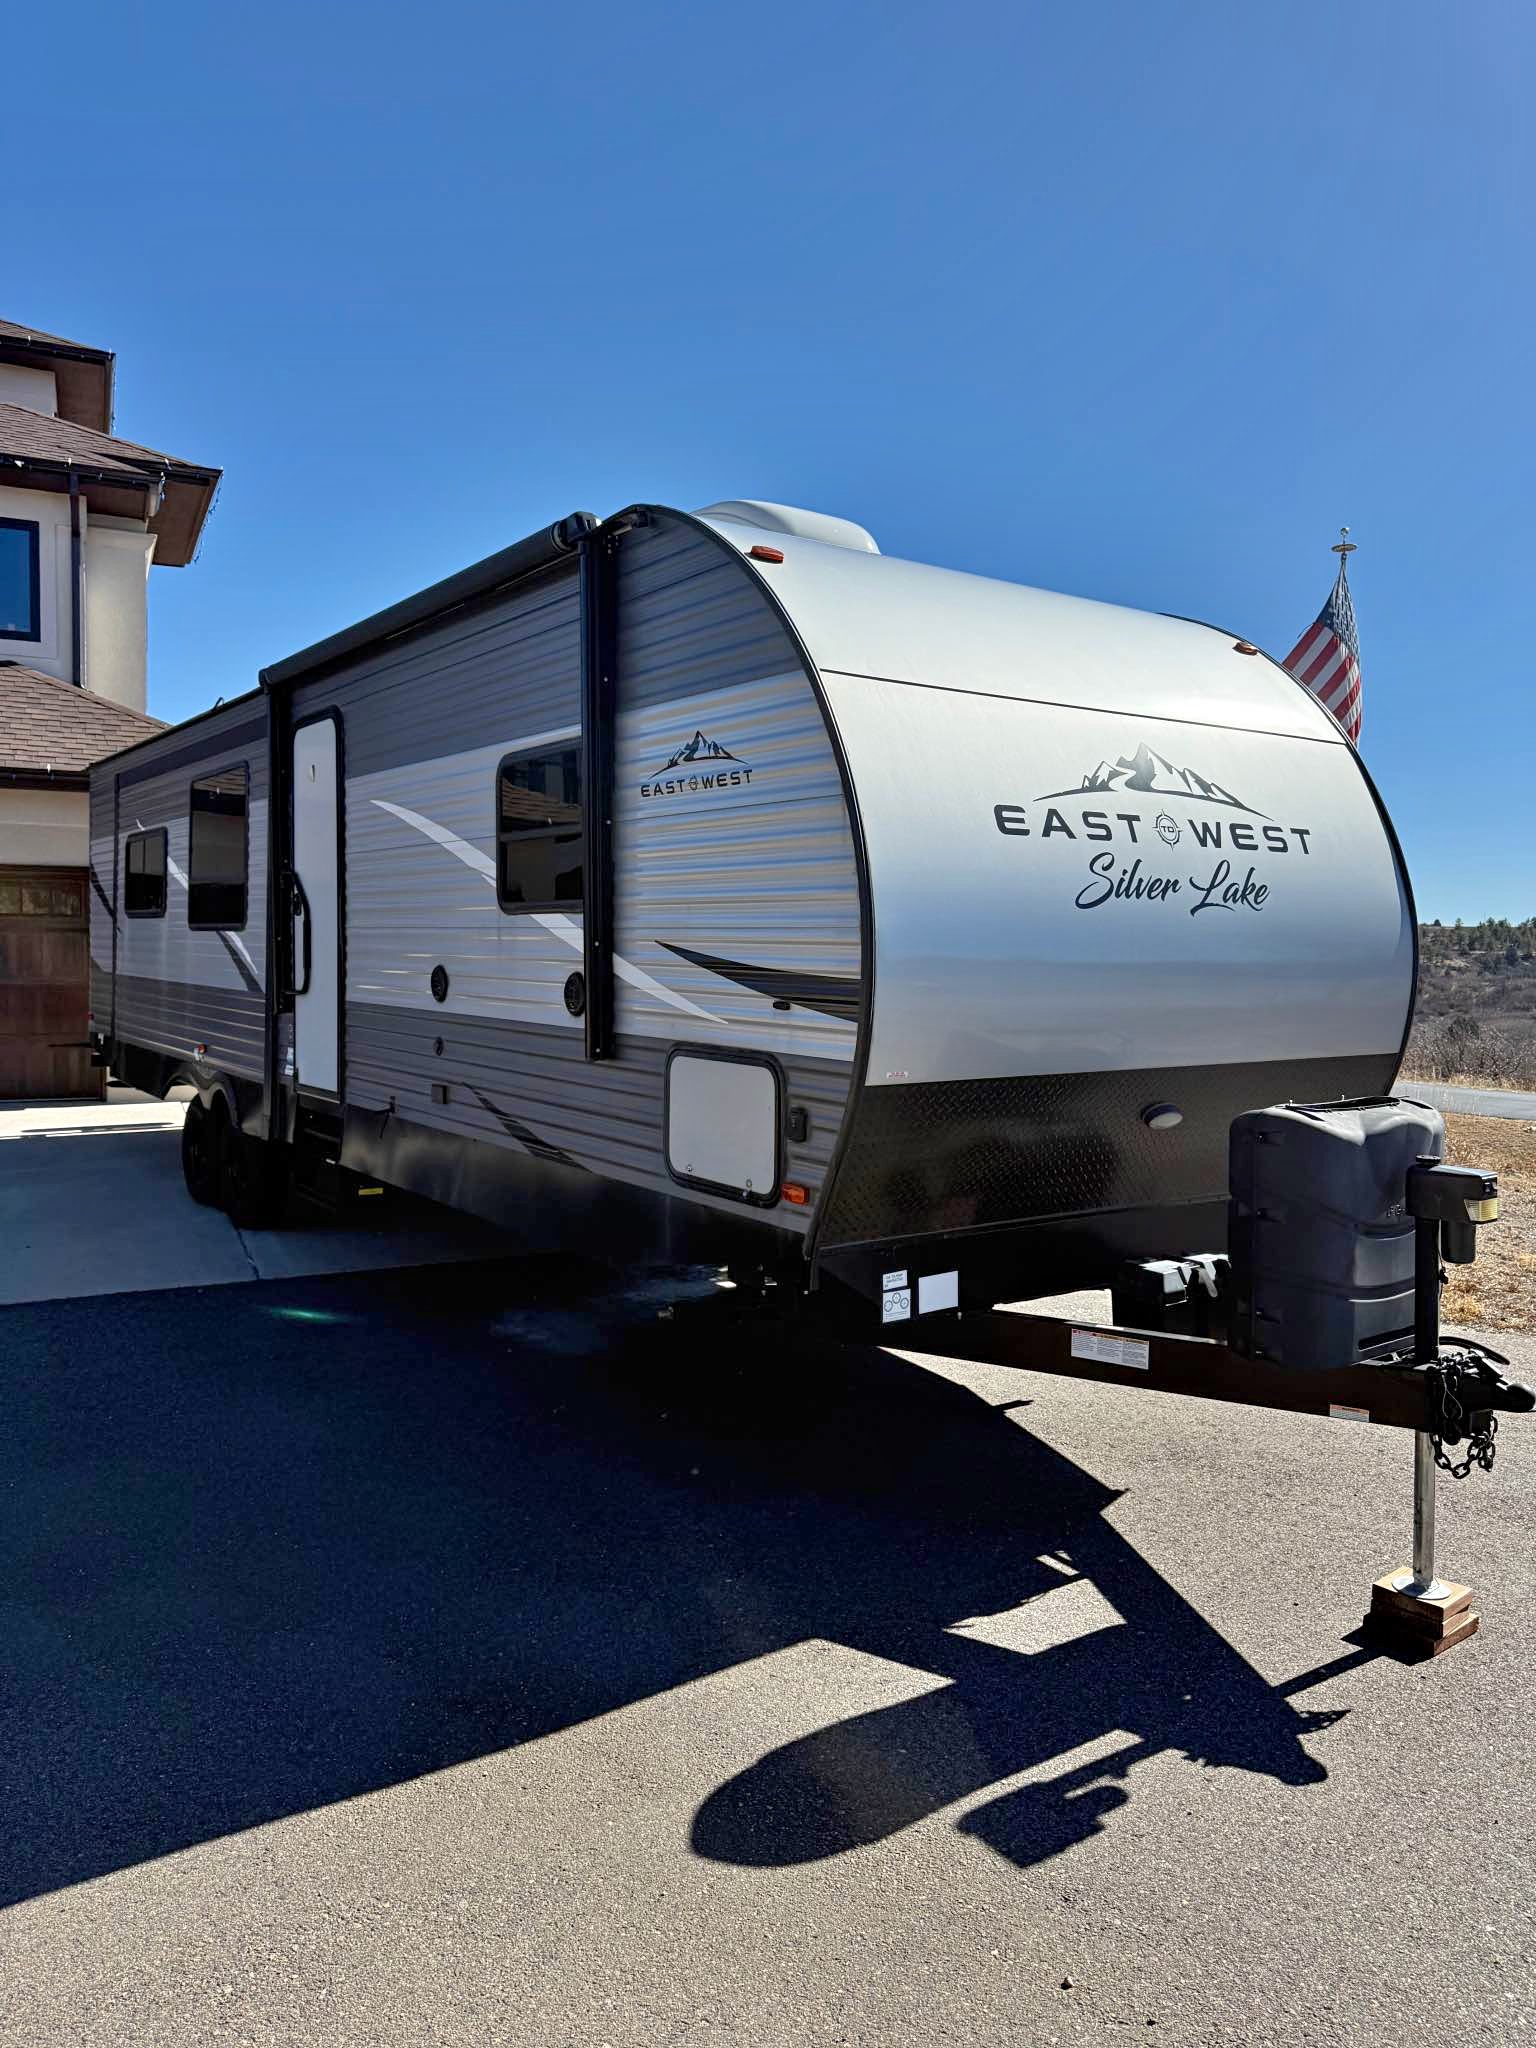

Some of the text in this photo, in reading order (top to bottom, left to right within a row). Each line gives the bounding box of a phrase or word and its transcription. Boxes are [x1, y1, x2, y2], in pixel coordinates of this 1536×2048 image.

[640, 769, 753, 798] EAST WEST
[993, 803, 1313, 855] EAST TO WEST
[1075, 851, 1271, 918] Silver Lake
